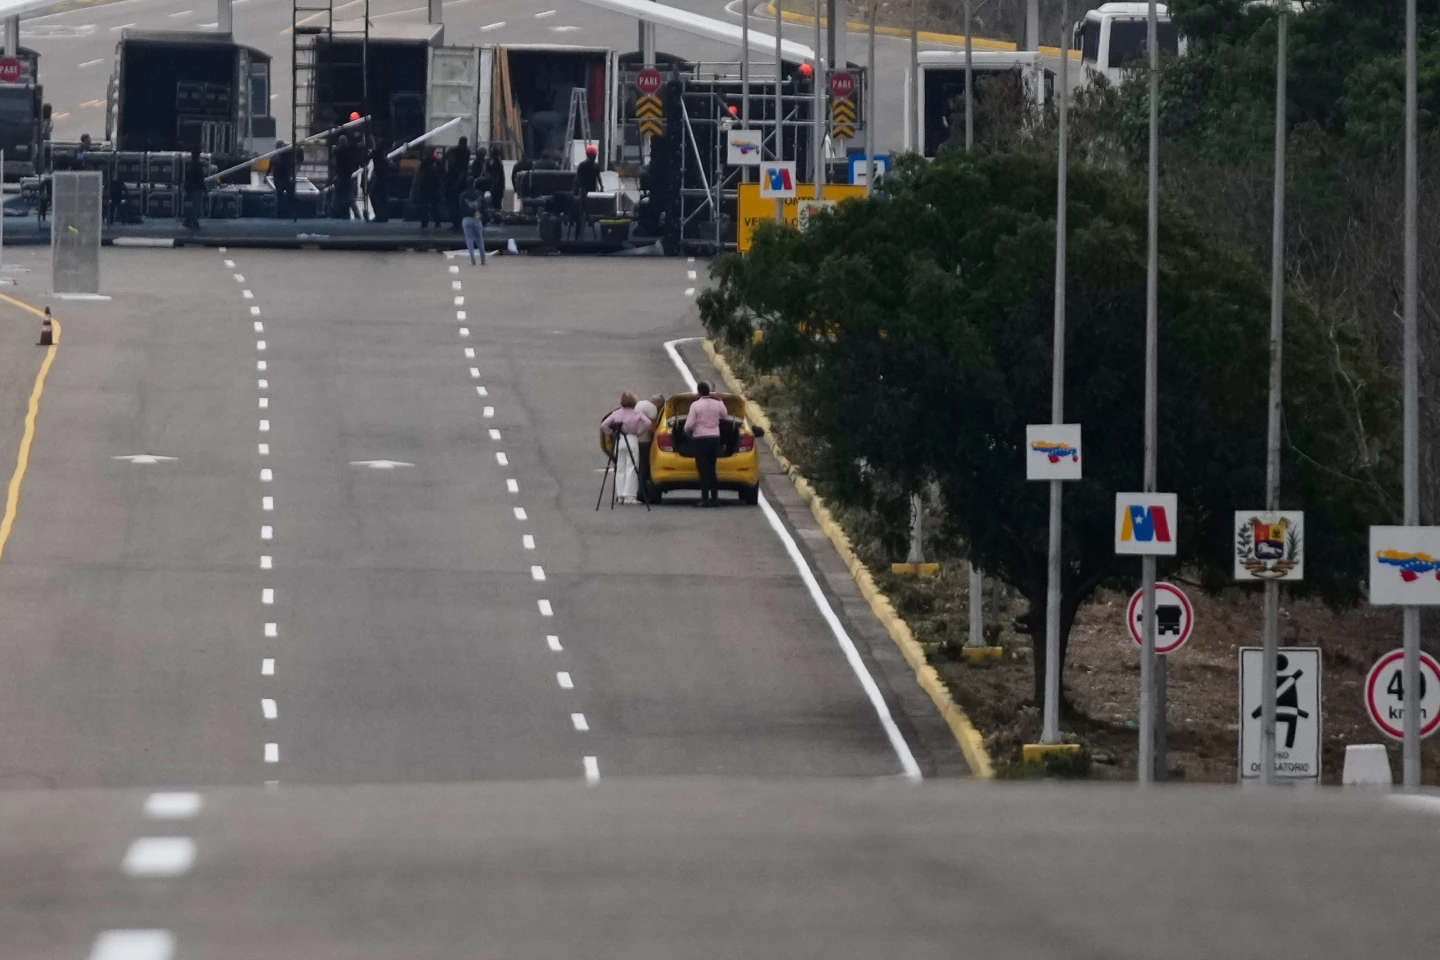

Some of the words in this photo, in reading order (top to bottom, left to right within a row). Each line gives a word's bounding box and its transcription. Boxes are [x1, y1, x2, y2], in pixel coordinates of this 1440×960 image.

[0, 65, 18, 74] PARE
[639, 76, 659, 85] PARE
[832, 79, 852, 88] PARE
